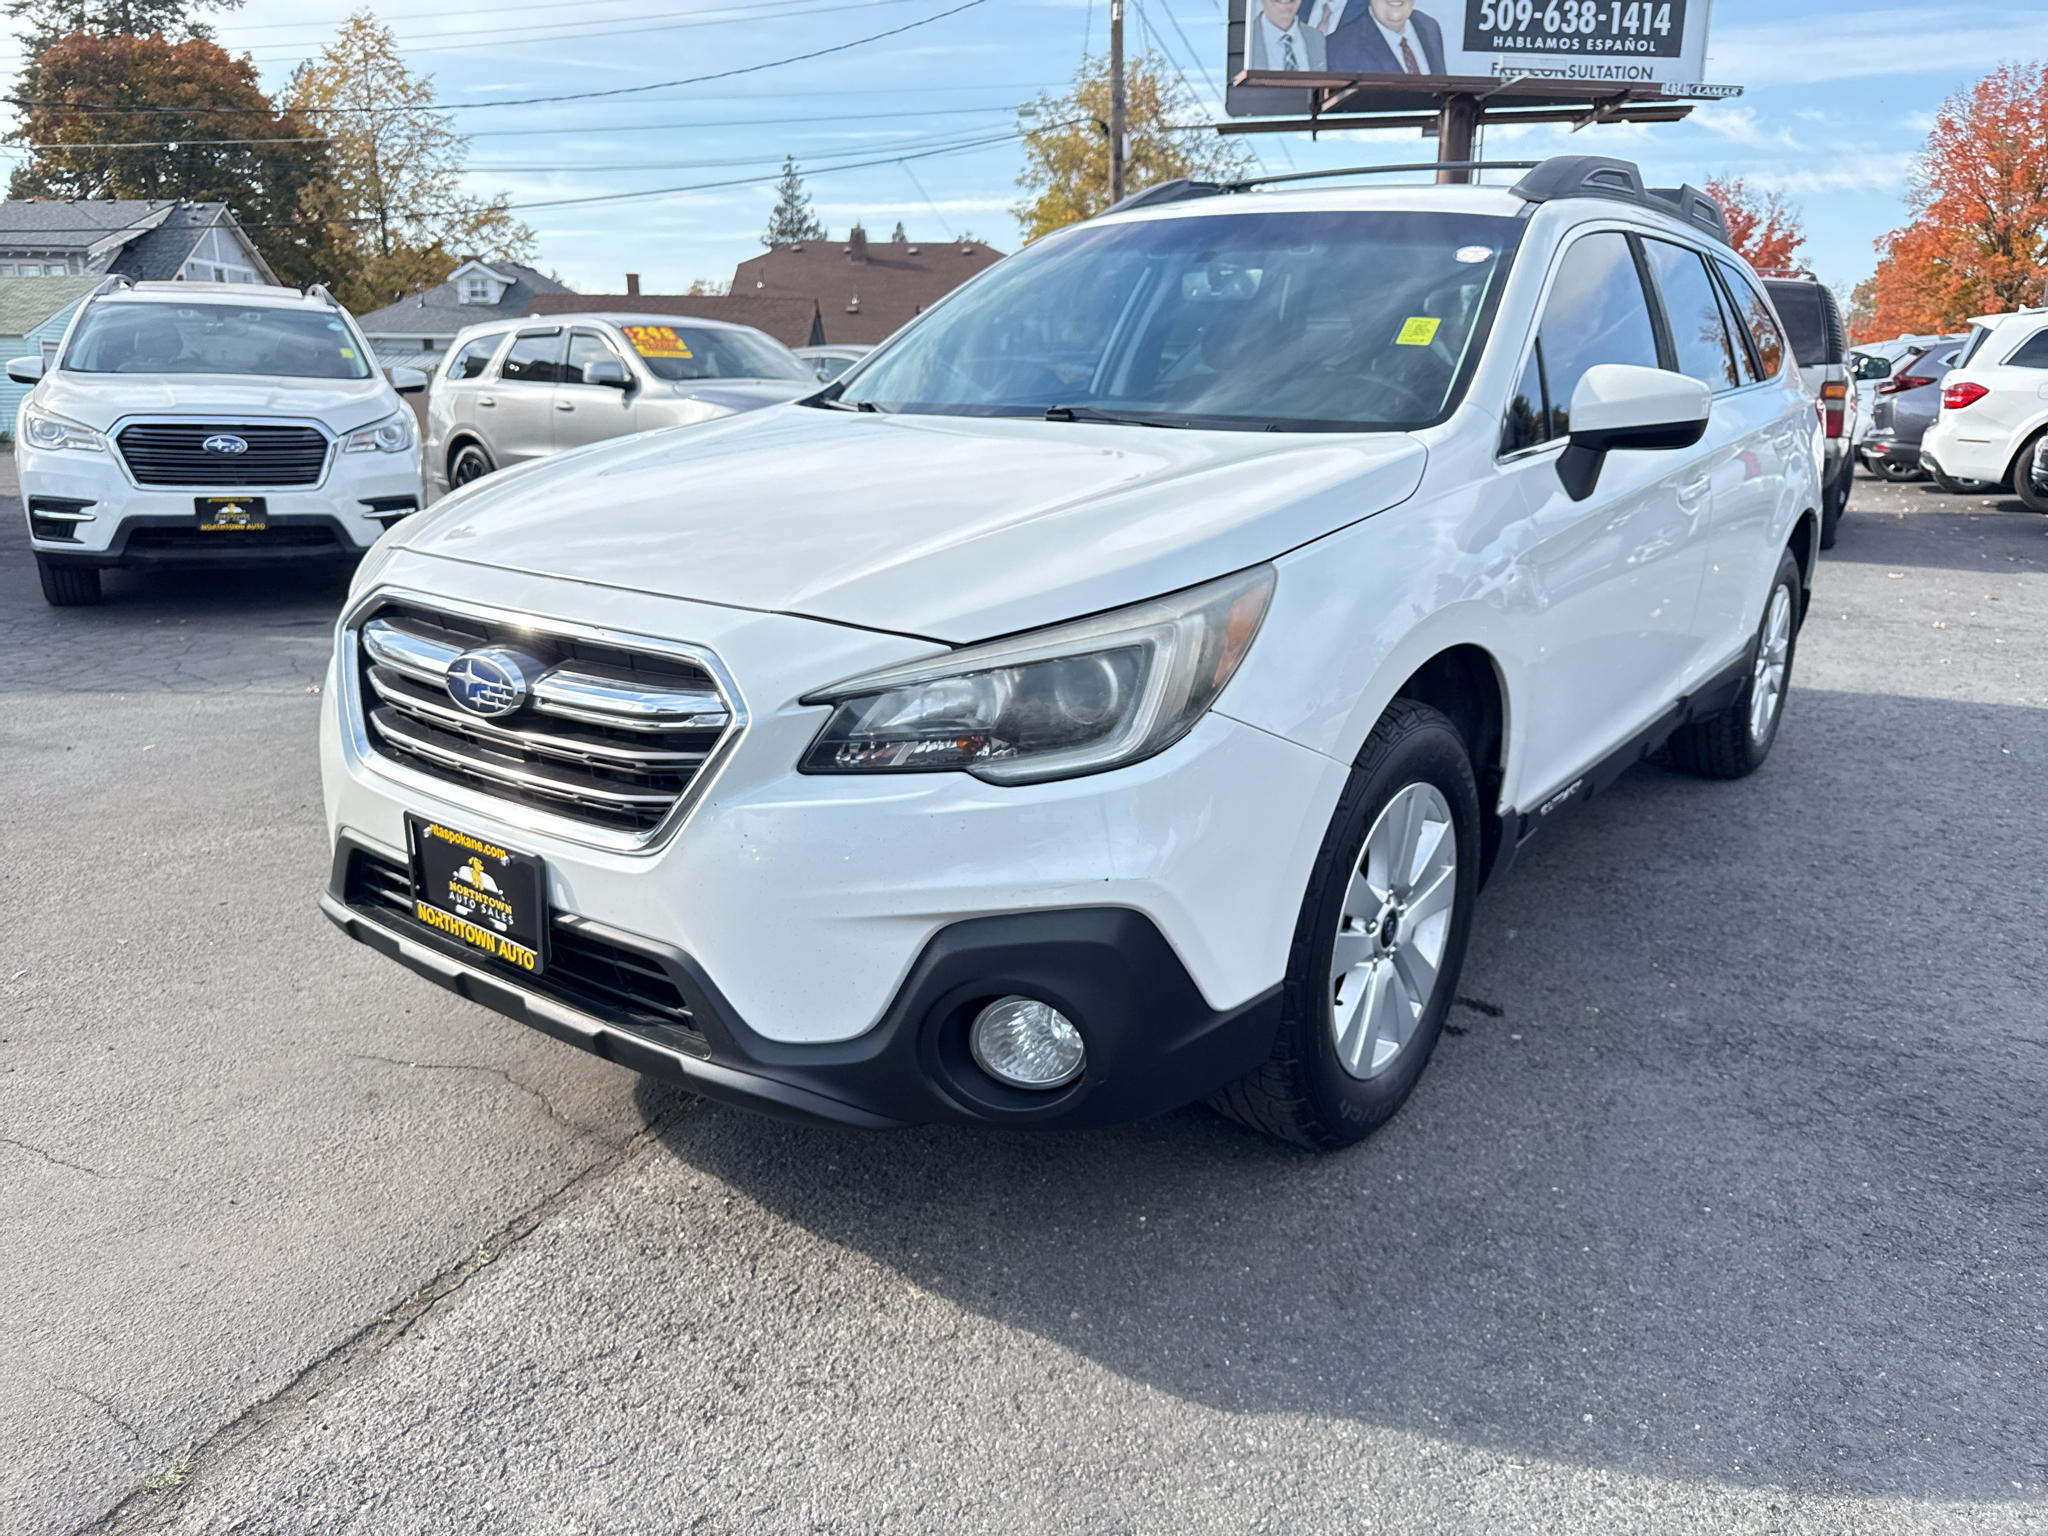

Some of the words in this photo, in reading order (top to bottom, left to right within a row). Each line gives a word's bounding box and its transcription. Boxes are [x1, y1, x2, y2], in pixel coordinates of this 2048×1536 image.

[1478, 0, 1671, 36] 509-638-1414
[1493, 35, 1580, 50] HABLAMOS
[1586, 37, 1656, 52] ESPAÑOL
[449, 881, 513, 915] NORTHTOWN
[449, 892, 476, 910] AUTO
[480, 904, 514, 925] SALES
[417, 903, 496, 952] NORTHTOWN
[498, 939, 535, 970] AUTO
